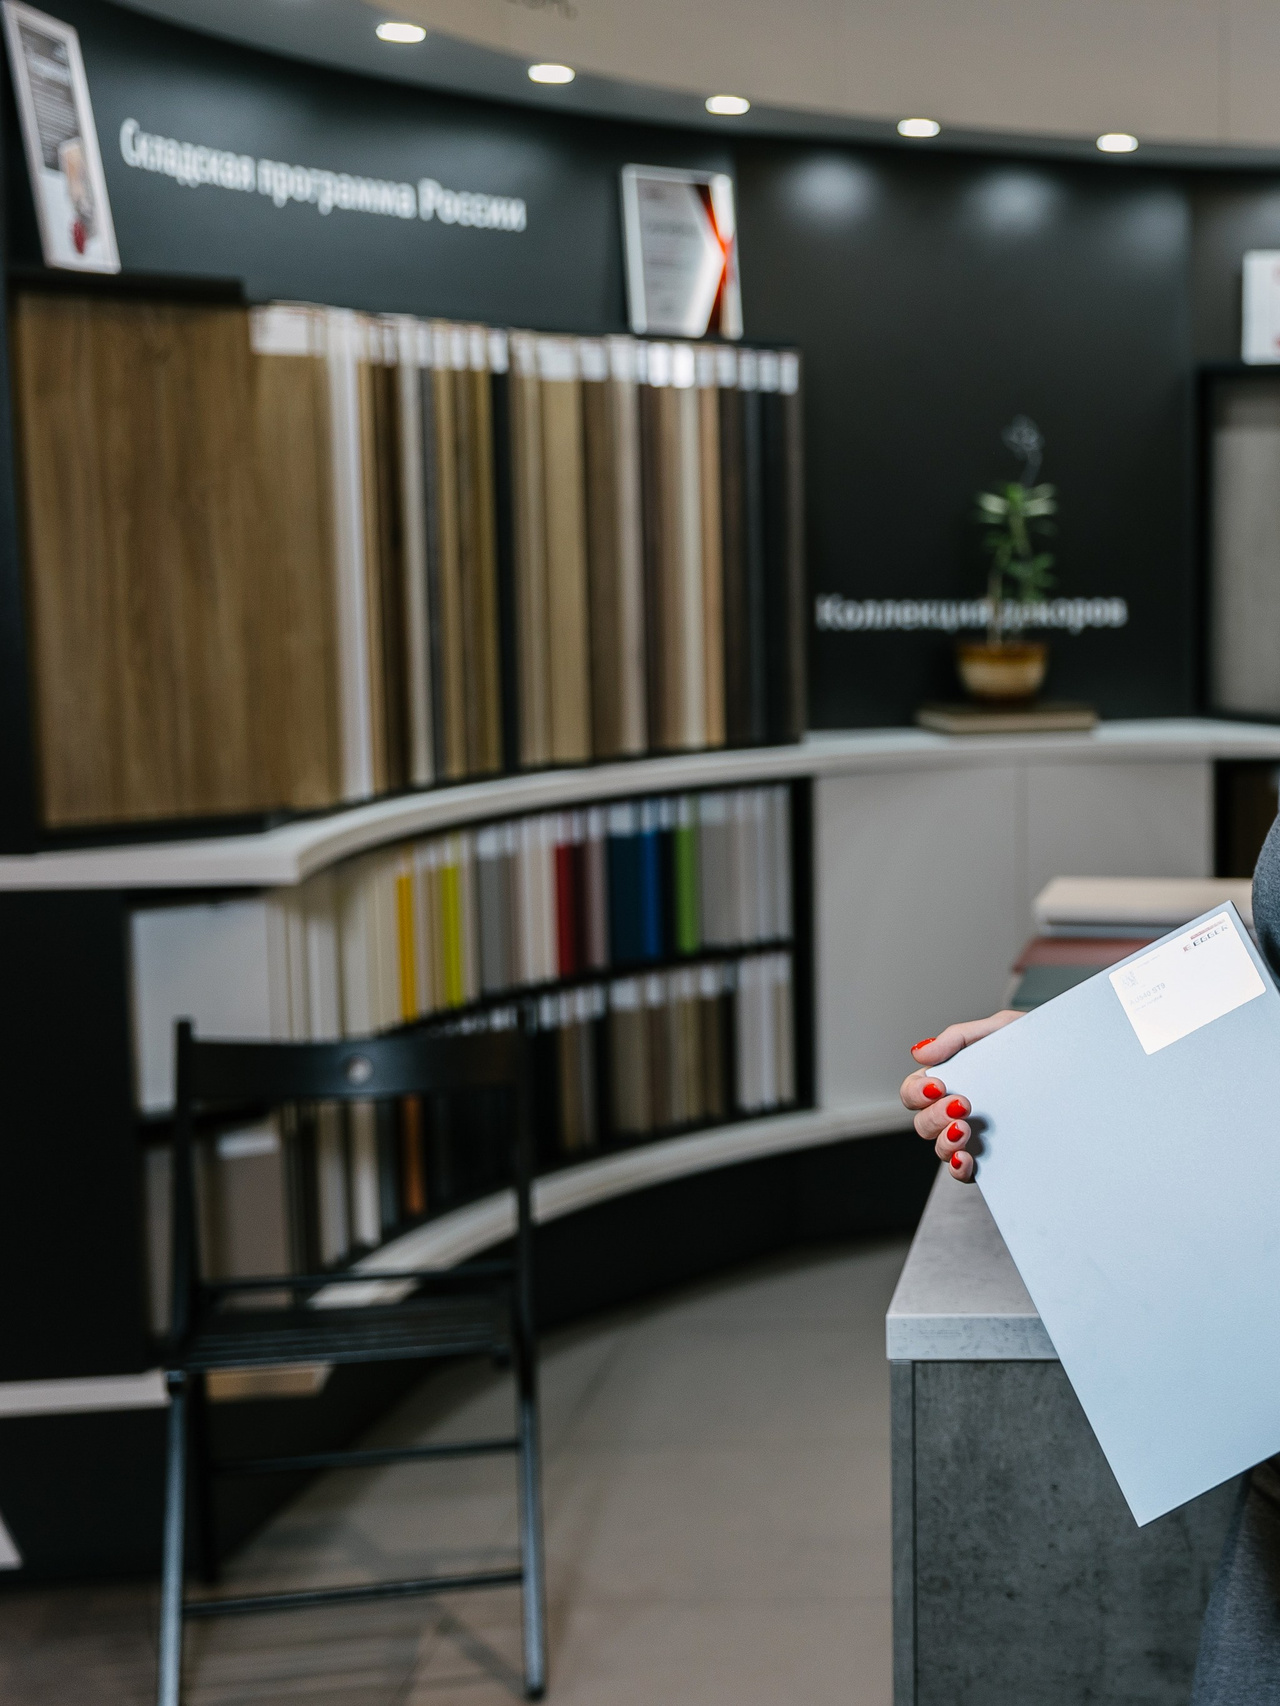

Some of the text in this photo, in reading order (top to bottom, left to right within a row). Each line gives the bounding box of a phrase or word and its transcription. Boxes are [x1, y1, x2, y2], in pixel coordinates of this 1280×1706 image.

[119, 117, 527, 232] Складская программа России
